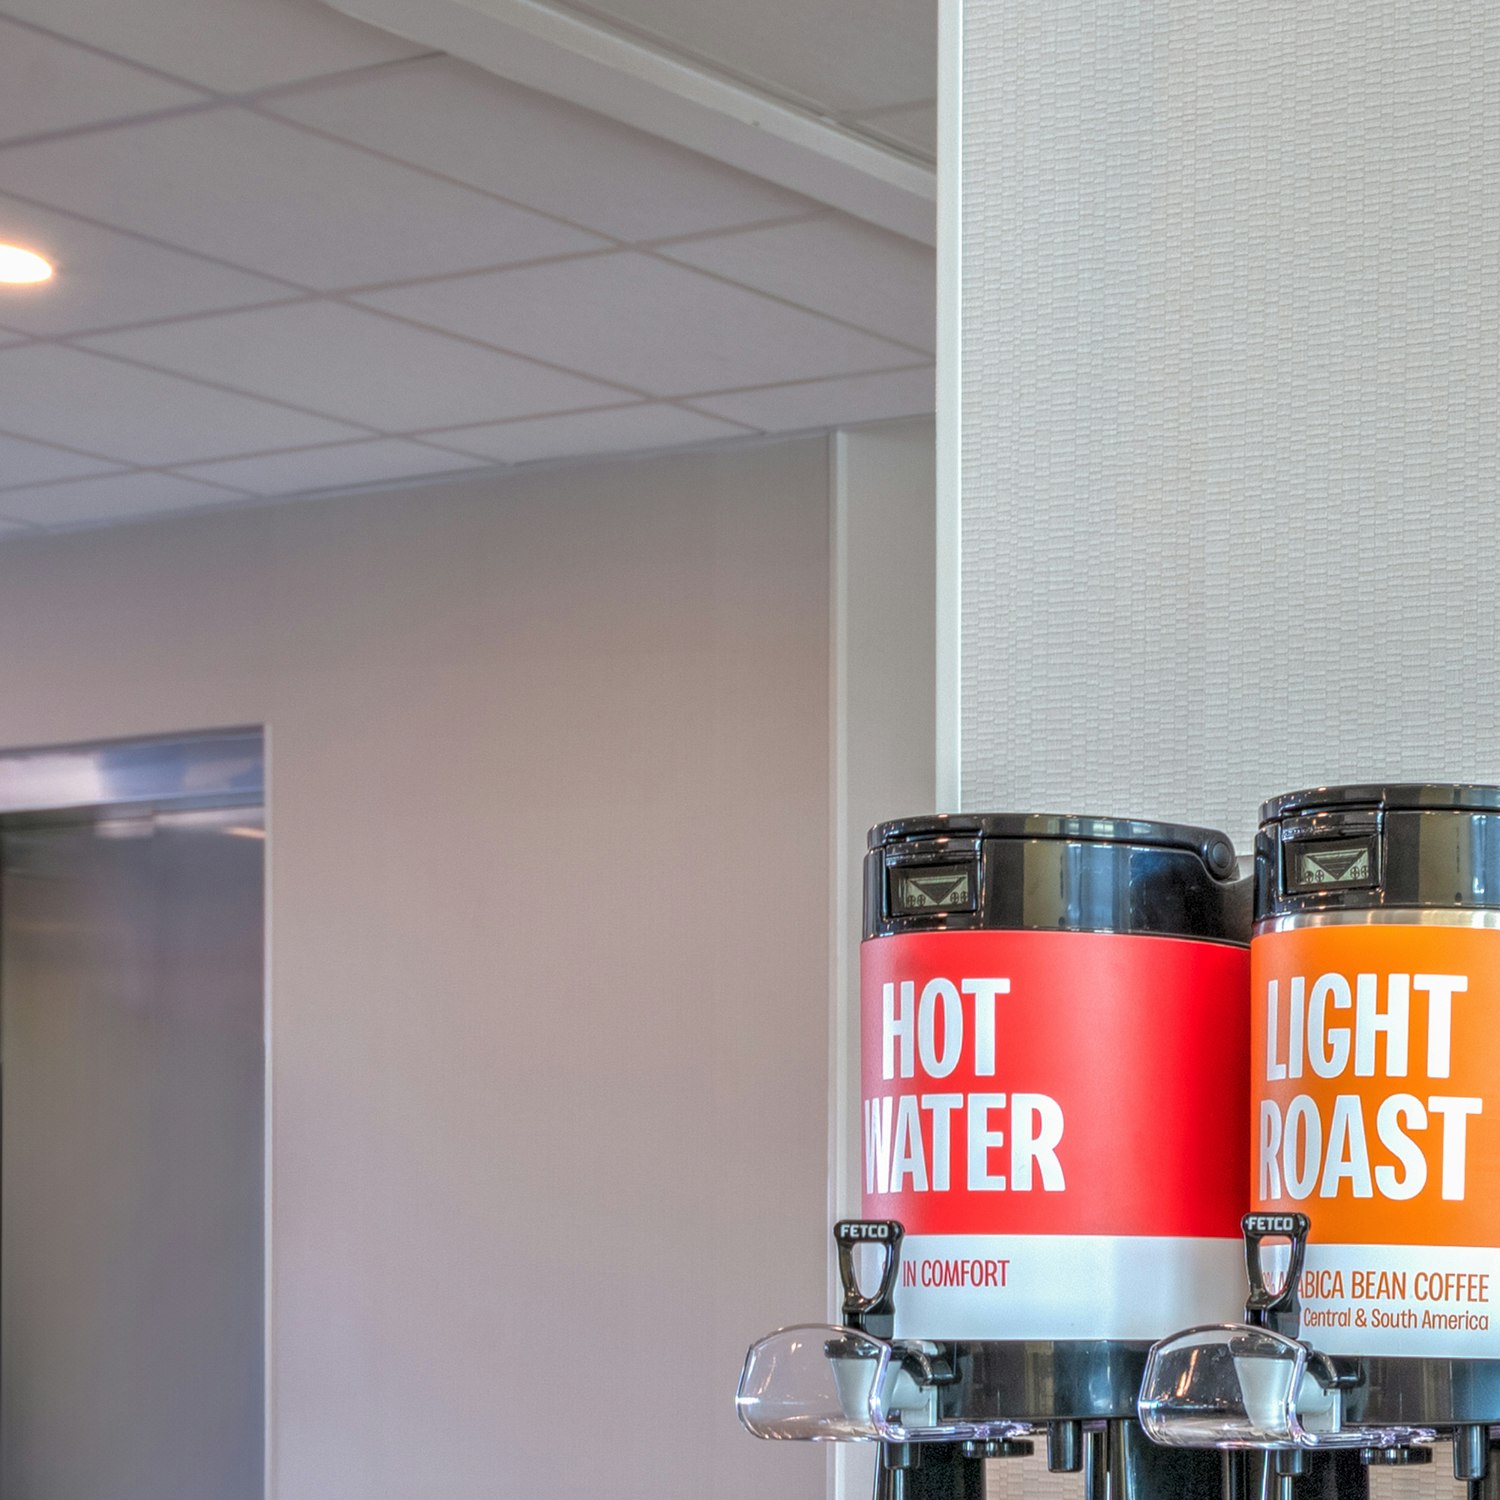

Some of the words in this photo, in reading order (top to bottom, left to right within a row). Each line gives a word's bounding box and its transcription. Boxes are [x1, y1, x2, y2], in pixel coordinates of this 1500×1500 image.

[881, 977, 1011, 1081] HOT
[1264, 972, 1468, 1083] LIGHT
[863, 1092, 1067, 1196] WATER
[1258, 1093, 1483, 1202] ROAST
[839, 1223, 889, 1238] FETCO
[1247, 1216, 1294, 1231] FETCO
[903, 1259, 917, 1288] IN
[921, 1259, 1011, 1288] COMFORT
[1351, 1270, 1407, 1301] BEAN
[1414, 1271, 1490, 1303] COFFEE
[1303, 1306, 1351, 1328] Central
[1354, 1308, 1368, 1329] &
[1371, 1307, 1418, 1329] South
[1421, 1309, 1489, 1331] America
